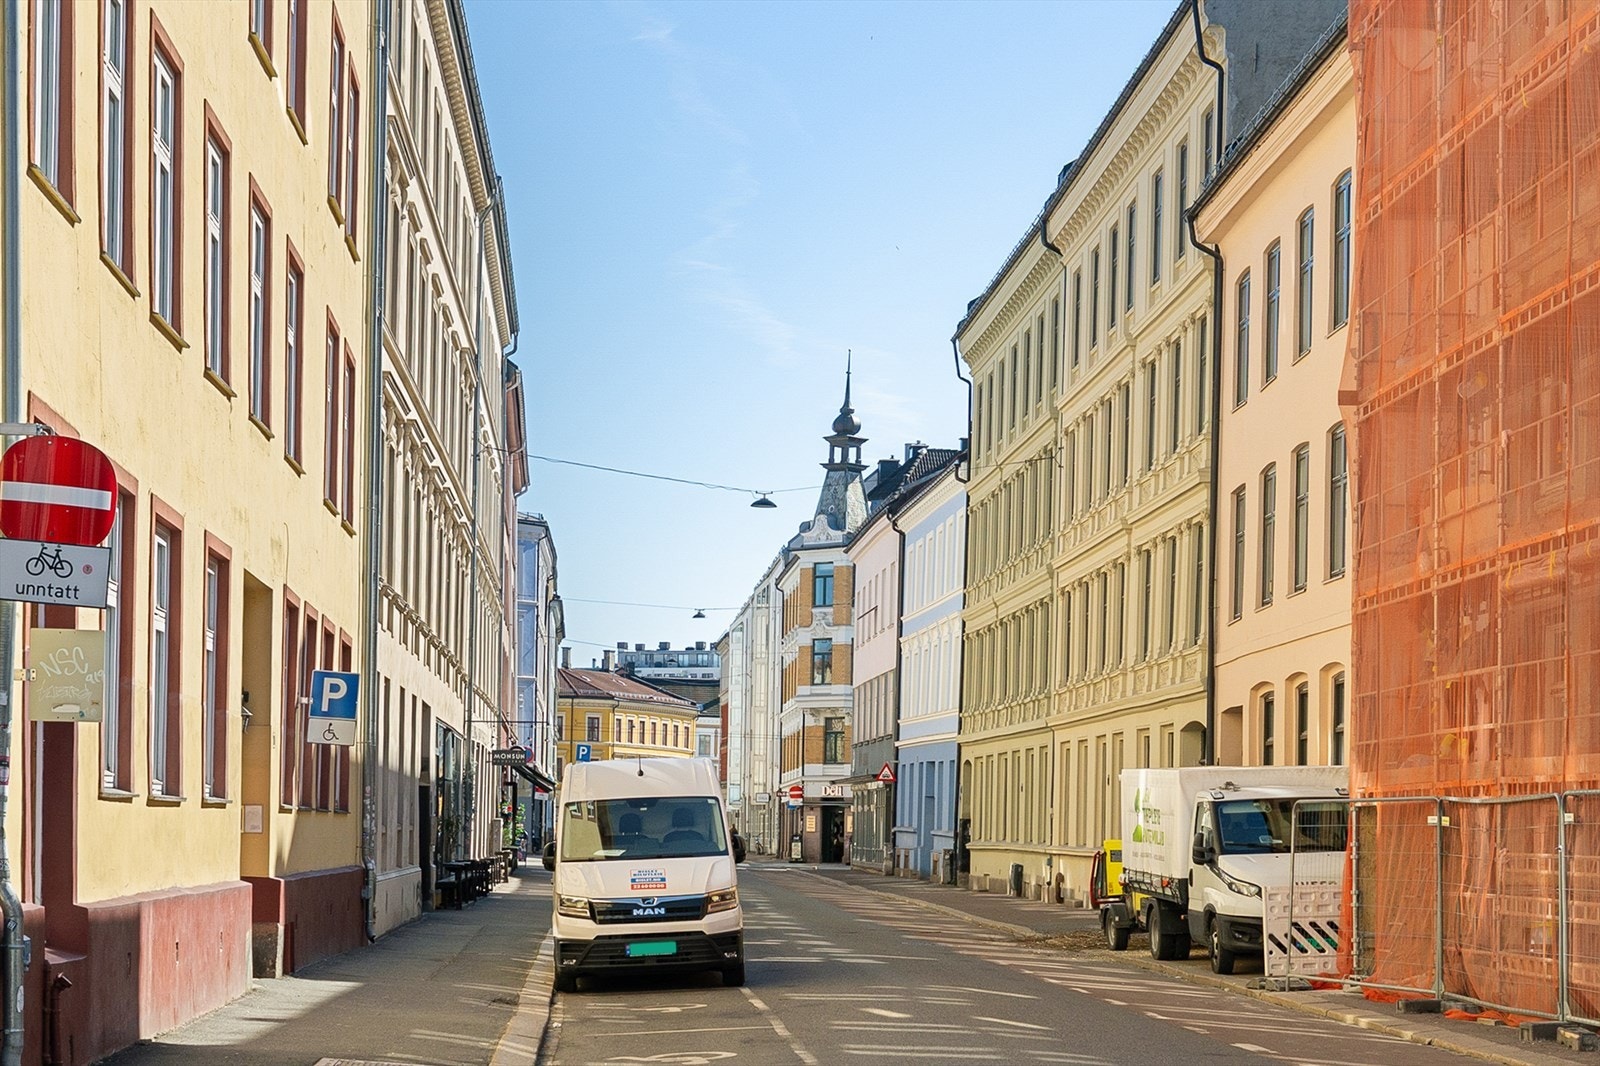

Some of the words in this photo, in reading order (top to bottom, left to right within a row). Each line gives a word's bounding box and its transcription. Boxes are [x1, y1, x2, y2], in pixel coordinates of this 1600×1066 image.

[15, 583, 79, 599] unntatt
[321, 677, 347, 712] P
[578, 746, 588, 759] P
[632, 907, 665, 916] MAN
